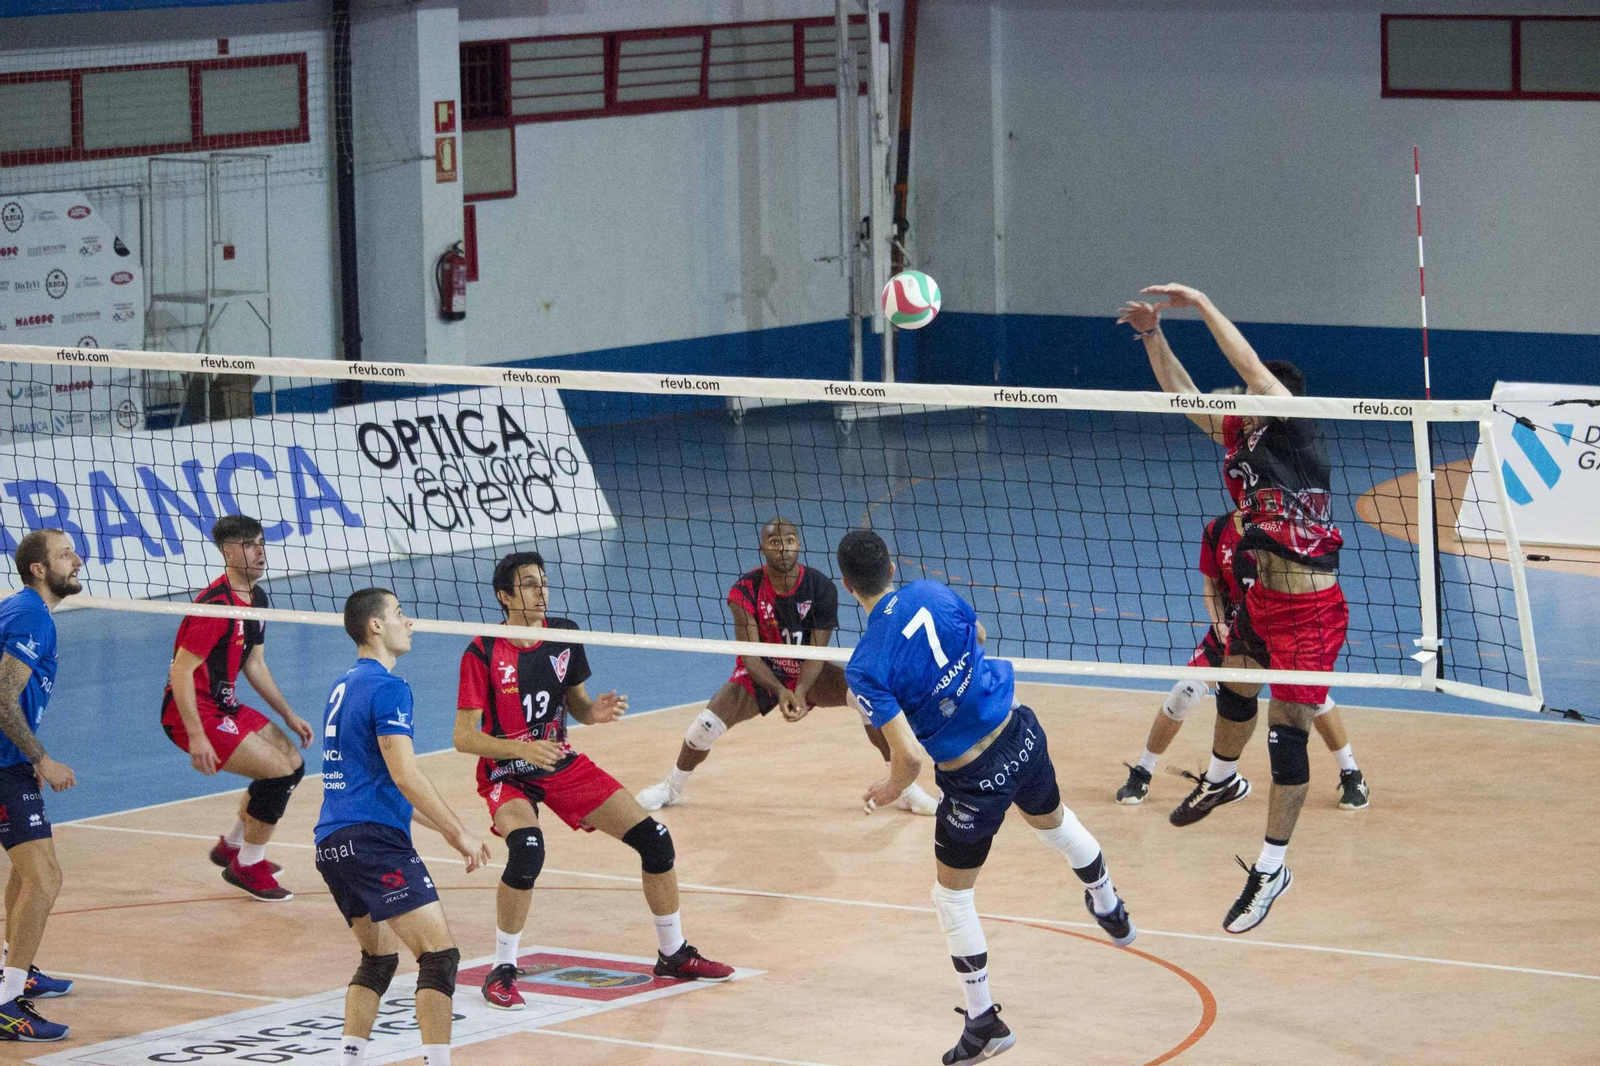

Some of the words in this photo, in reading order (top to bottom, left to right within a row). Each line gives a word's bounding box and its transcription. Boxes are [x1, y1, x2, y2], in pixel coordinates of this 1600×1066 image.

[57, 349, 109, 363] rfevb.com
[200, 356, 255, 370] rfevb.com
[348, 363, 405, 377] rfevb.com
[502, 370, 561, 384] rfevb.com
[660, 377, 720, 391] rfevb.com
[824, 383, 886, 397] rfevb.com
[993, 389, 1058, 403] rfevb.com
[1170, 395, 1236, 409] rfevb.com
[1352, 401, 1412, 416] rfevb.co
[358, 406, 535, 470] OPTICA
[414, 440, 579, 498] eduardo
[386, 463, 562, 533] varela
[902, 607, 949, 669] 7
[325, 682, 345, 737] 2
[523, 691, 550, 722] 13
